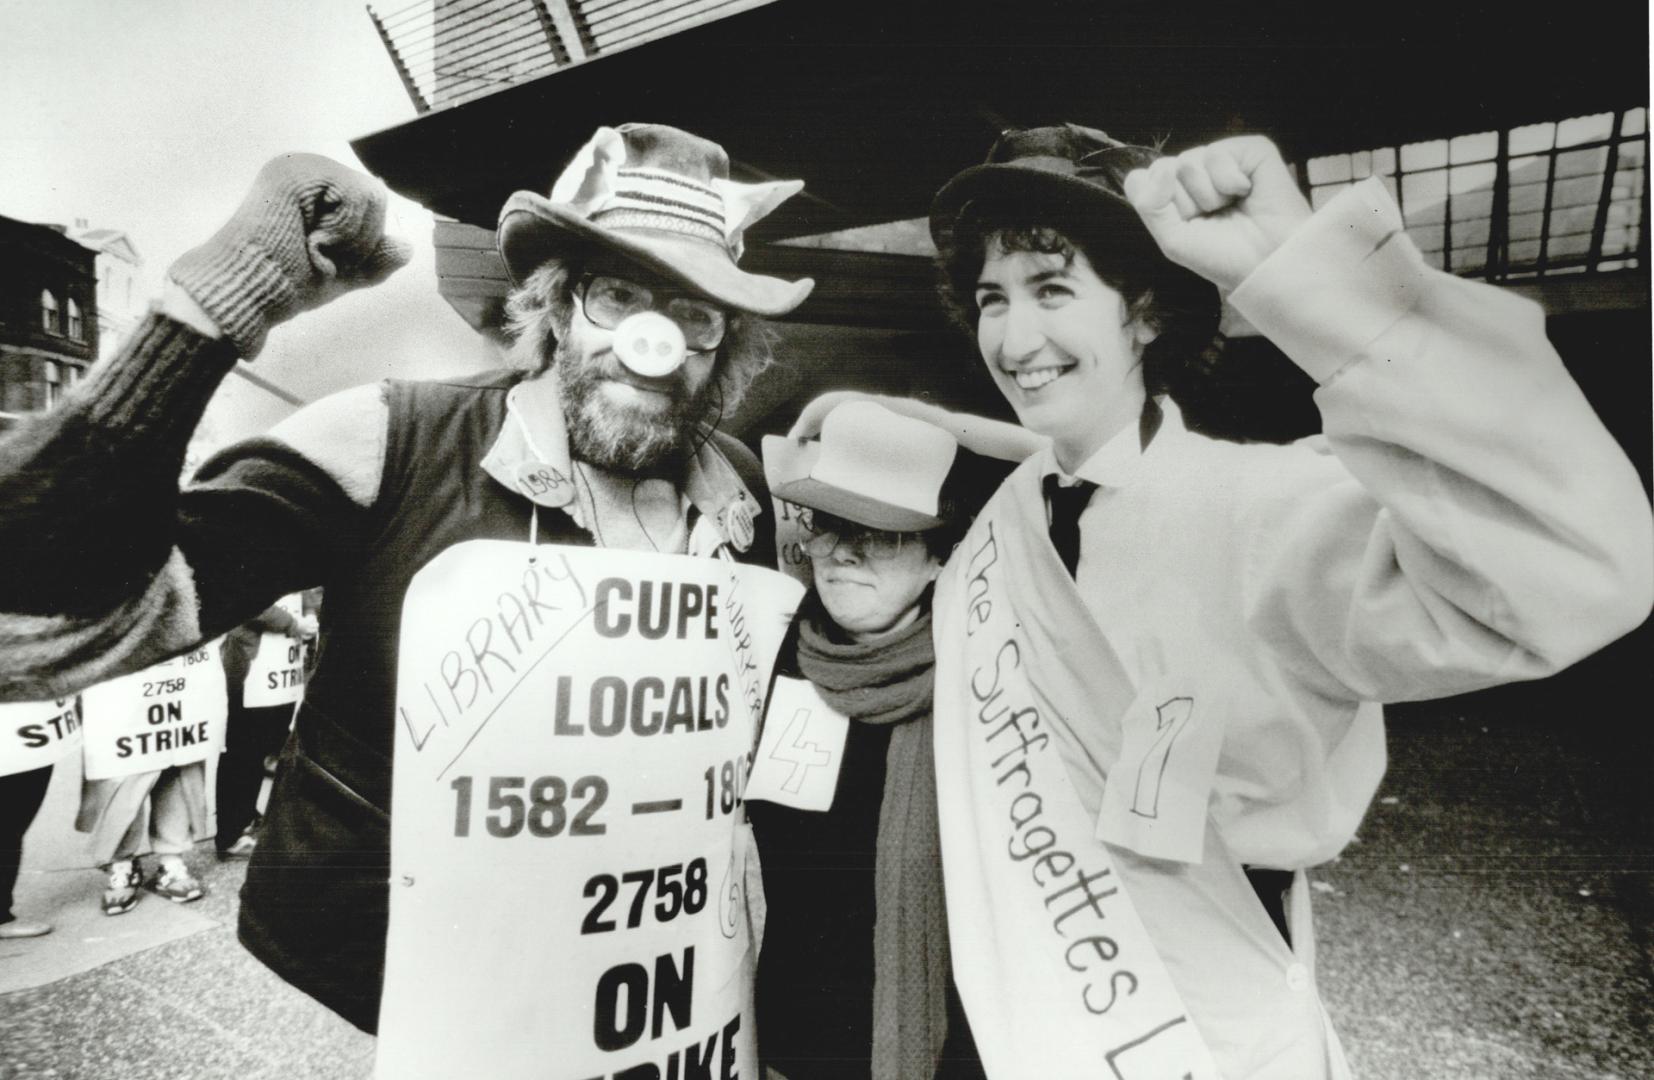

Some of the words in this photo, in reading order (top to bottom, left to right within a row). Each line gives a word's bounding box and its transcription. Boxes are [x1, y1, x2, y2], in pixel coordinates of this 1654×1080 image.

[518, 467, 569, 497] 1984
[593, 577, 719, 640] CUPE
[965, 520, 998, 637] The
[400, 554, 588, 752] LIBRARY
[142, 677, 186, 698] 2758
[147, 701, 183, 725] ON
[553, 673, 729, 737] LOCALS
[116, 721, 209, 758] STRIKE
[769, 707, 832, 795] 4
[450, 775, 609, 838] 1582
[971, 638, 1139, 1015] Suffragettes
[581, 857, 708, 935] 2758
[593, 945, 695, 1053] ON
